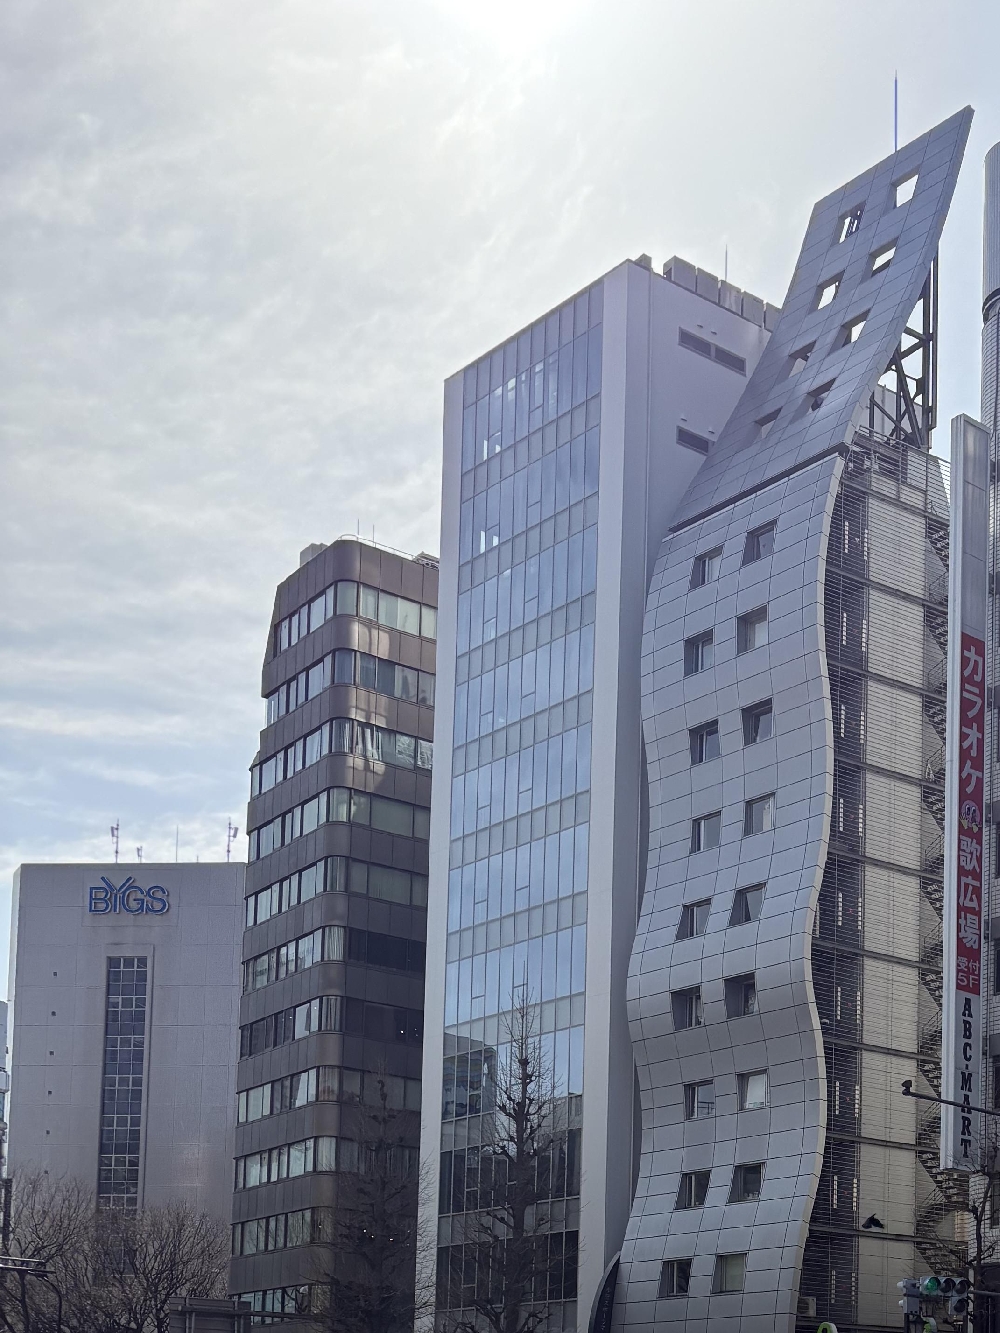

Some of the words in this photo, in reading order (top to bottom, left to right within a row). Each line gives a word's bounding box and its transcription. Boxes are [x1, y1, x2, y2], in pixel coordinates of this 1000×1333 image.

[961, 645, 983, 793] カラオケ
[89, 876, 169, 915] BYGS
[958, 835, 981, 949] 歌広場
[957, 956, 980, 975] 受付
[957, 973, 980, 988] 5F
[960, 997, 974, 1158] ABC-MART
